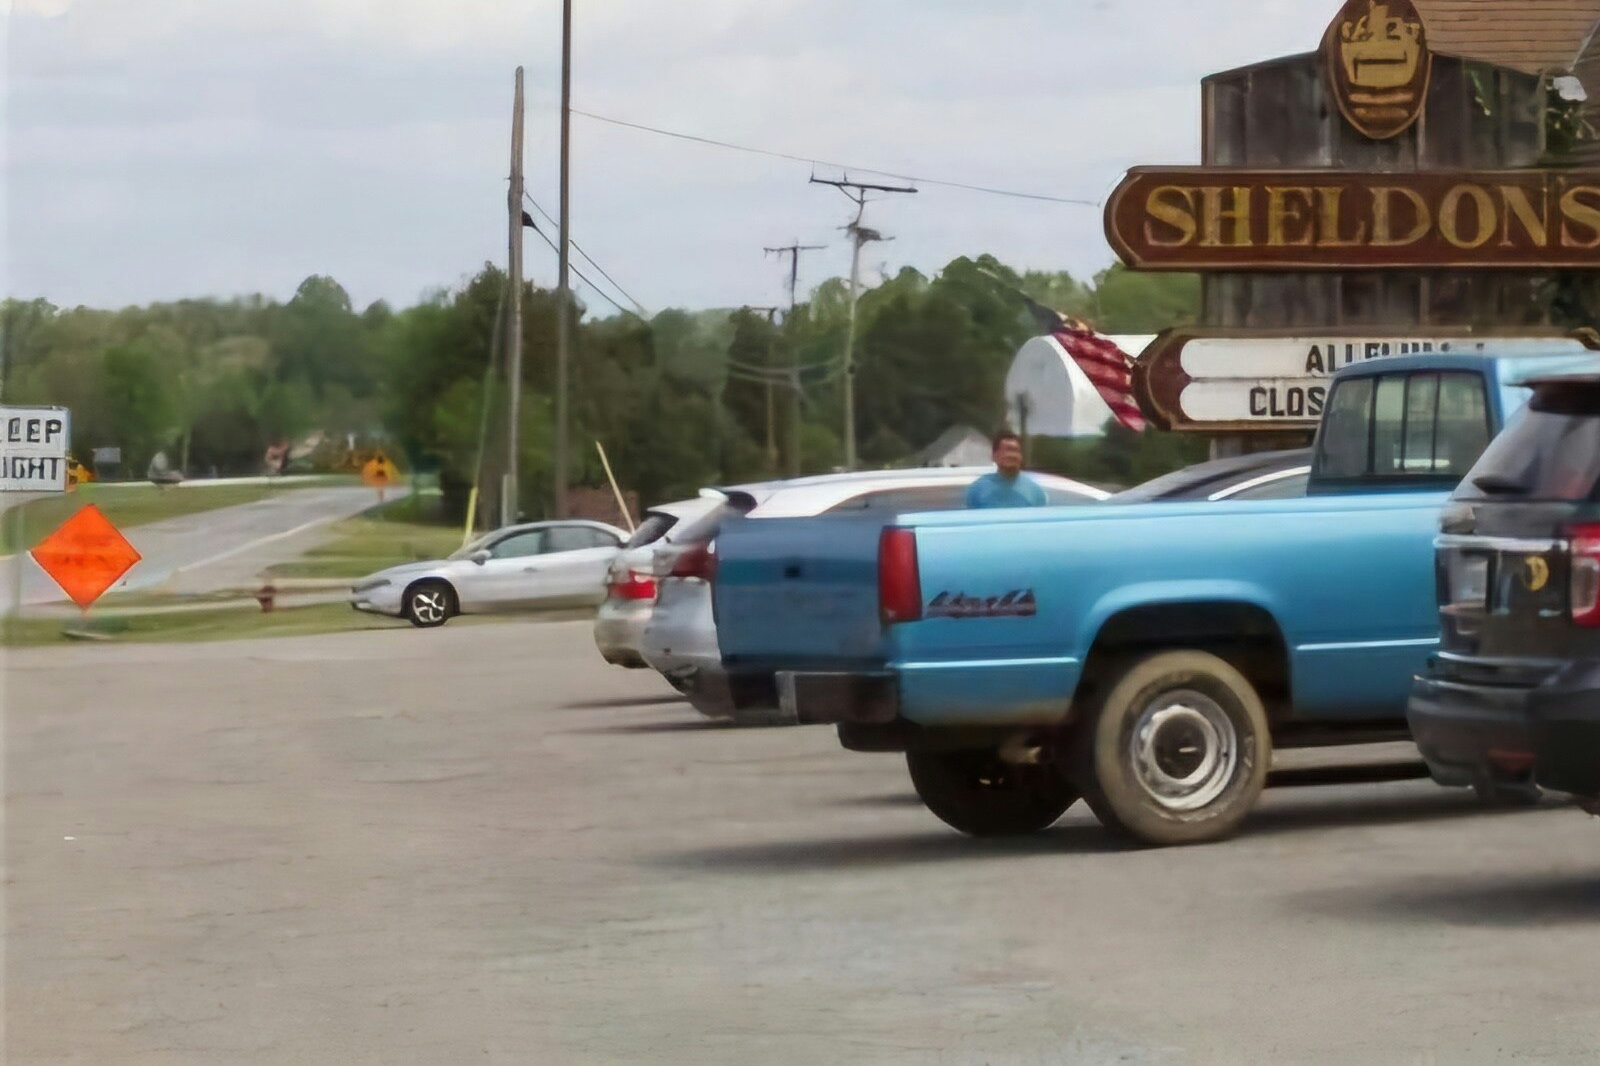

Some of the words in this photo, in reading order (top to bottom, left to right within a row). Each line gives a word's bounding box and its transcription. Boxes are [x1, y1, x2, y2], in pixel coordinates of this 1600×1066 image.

[1249, 386, 1326, 416] CLOS
[0, 418, 62, 443] EEP
[0, 456, 58, 480] IGHT
